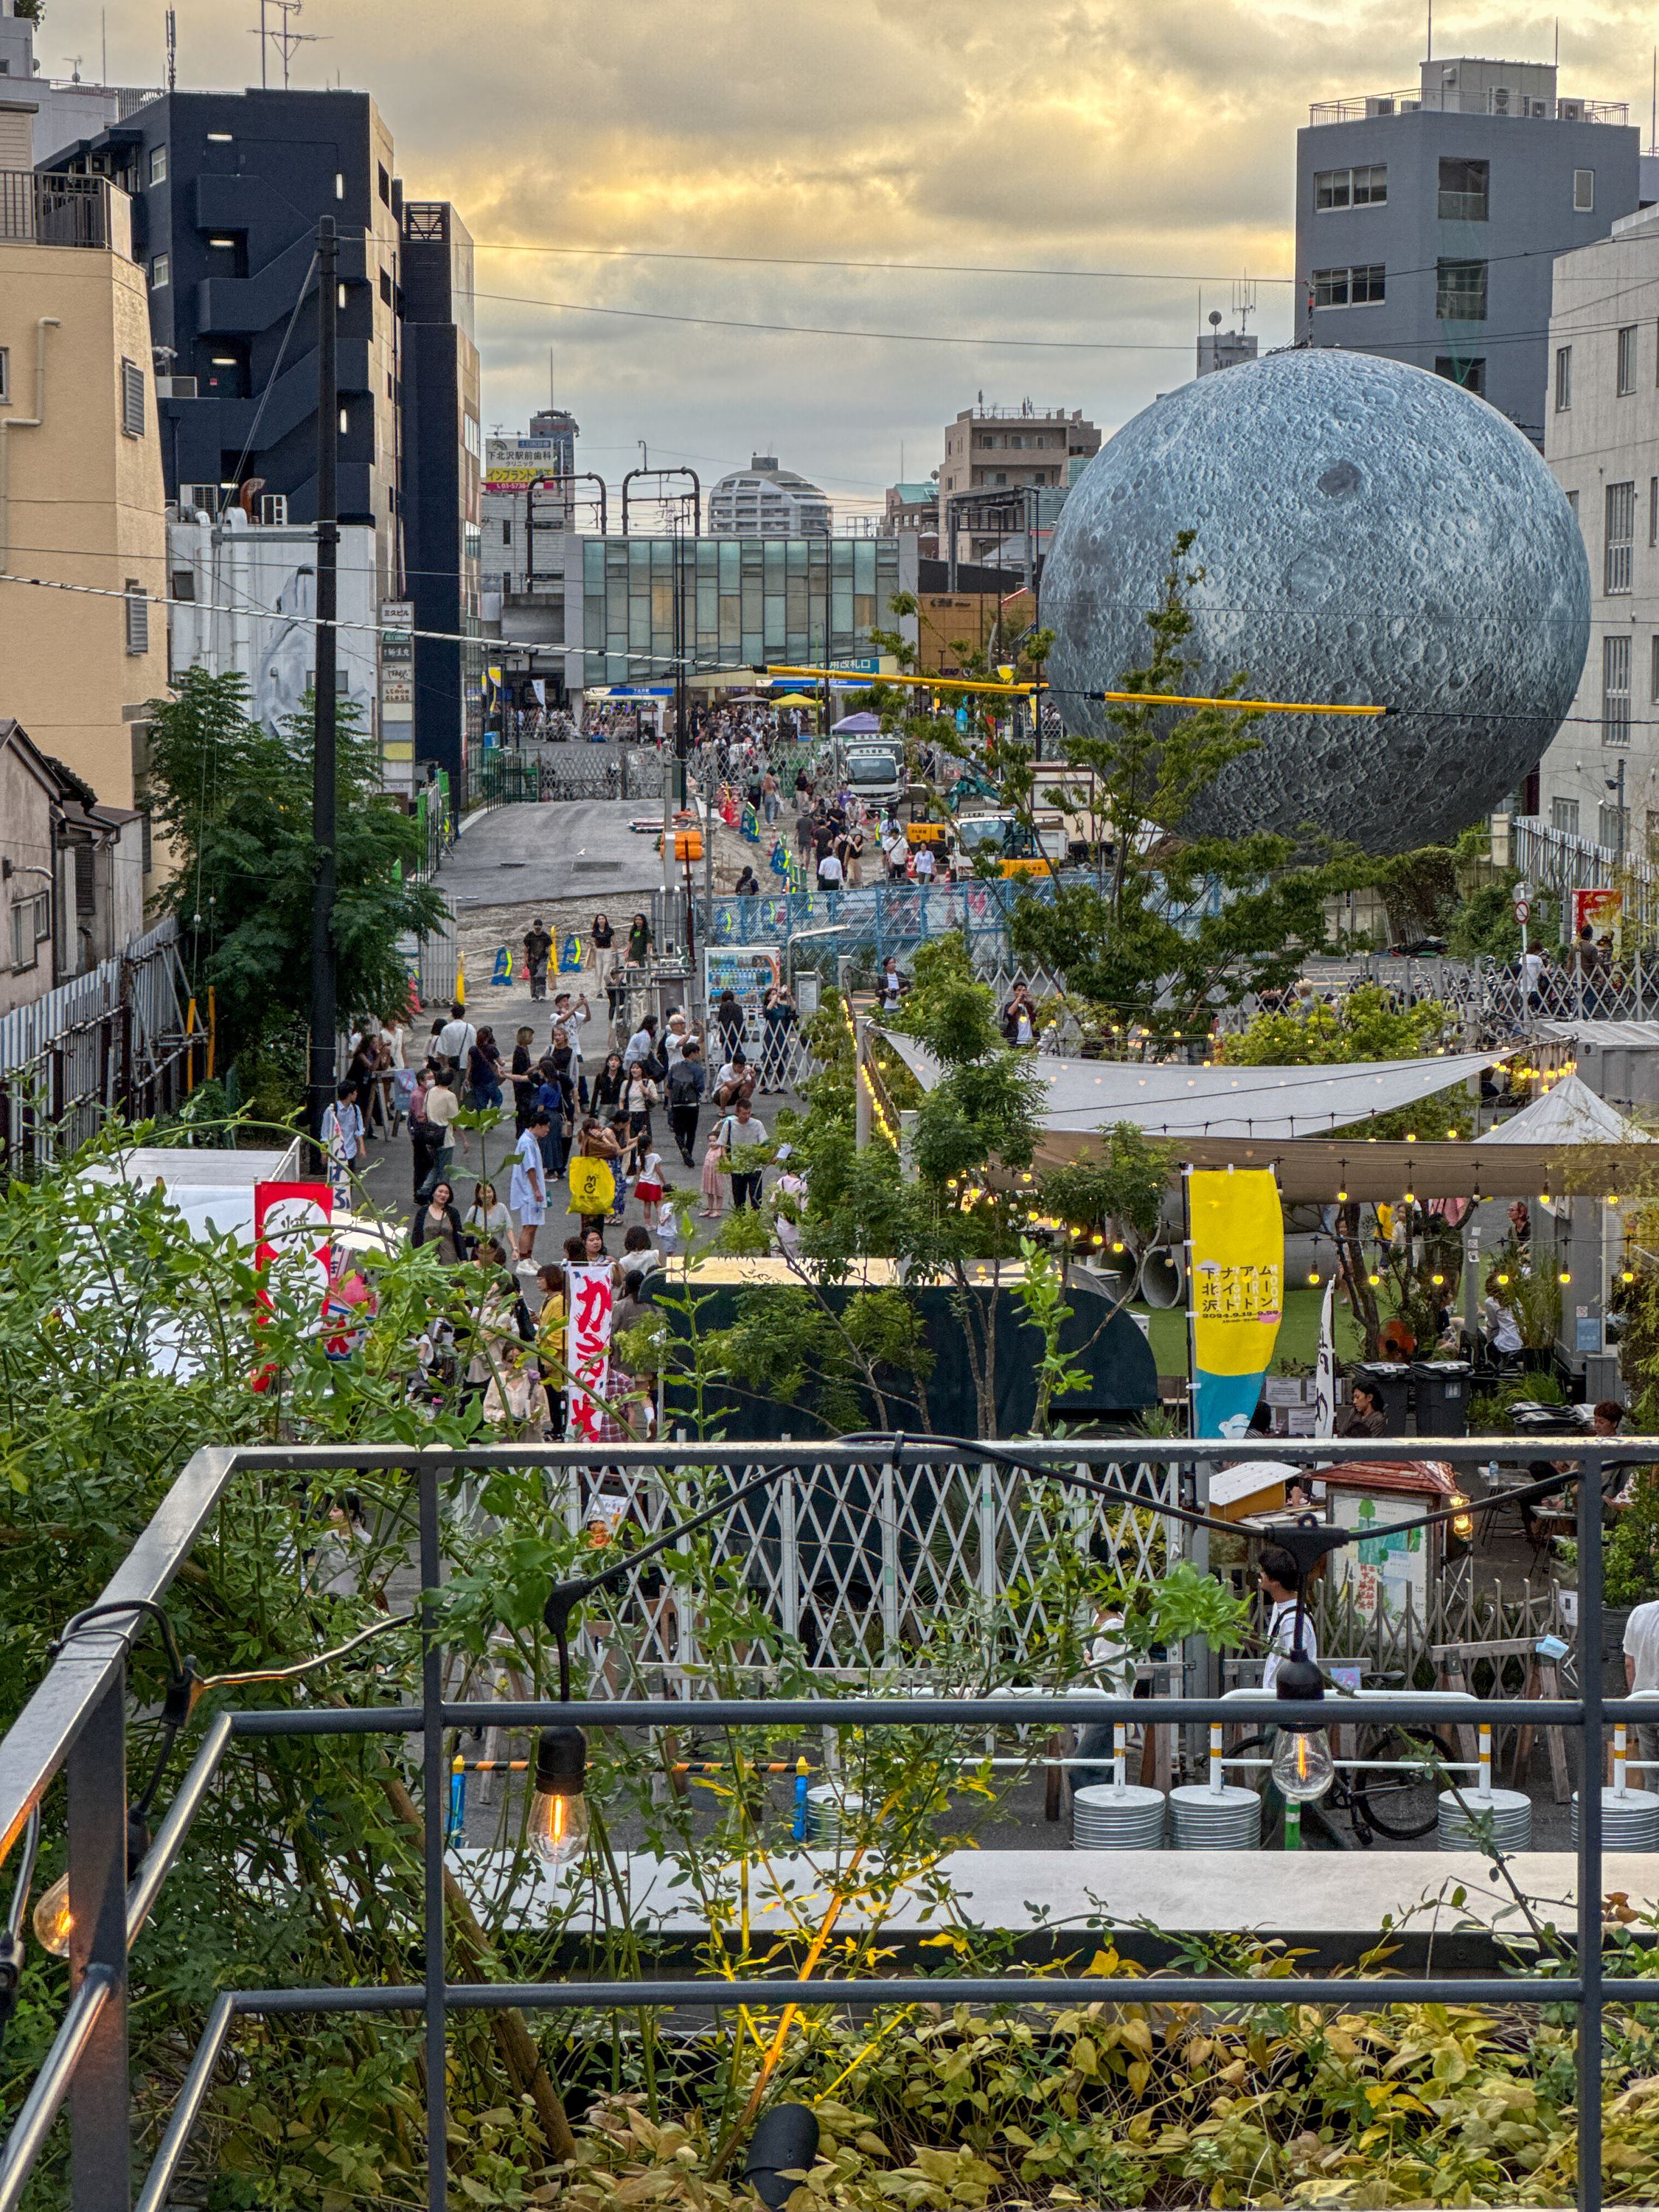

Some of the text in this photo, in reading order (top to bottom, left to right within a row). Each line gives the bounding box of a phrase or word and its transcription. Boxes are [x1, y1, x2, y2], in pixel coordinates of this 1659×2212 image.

[487, 451, 552, 460] 下北沢駅前歯科
[1200, 1267, 1218, 1312] 下北沢
